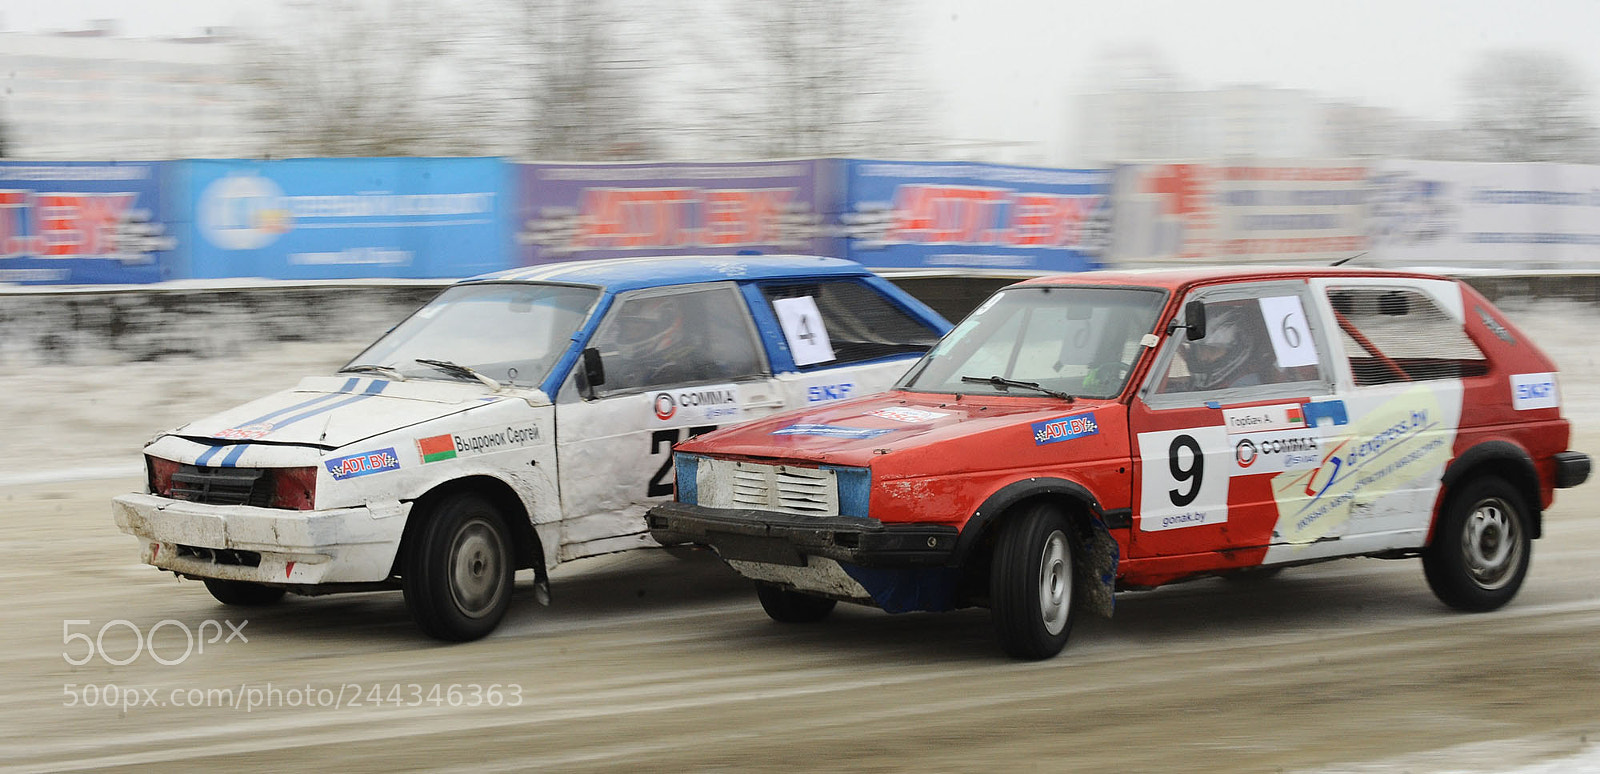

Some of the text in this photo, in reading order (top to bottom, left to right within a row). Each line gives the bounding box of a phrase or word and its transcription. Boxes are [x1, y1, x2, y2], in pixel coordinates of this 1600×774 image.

[796, 313, 816, 346] 4
[1282, 311, 1301, 349] 6
[680, 389, 737, 408] COMMA
[807, 383, 853, 403] SKF
[1516, 382, 1555, 401] SKF
[1044, 417, 1089, 440] ADT.BY
[1229, 415, 1263, 429] Горбач
[454, 423, 541, 454] Выдронок Сергей
[1261, 436, 1318, 455] COMMA
[341, 451, 389, 475] ADT.BY
[648, 424, 718, 497] 2
[1169, 434, 1204, 507] 9
[1162, 512, 1206, 528] gonak.by
